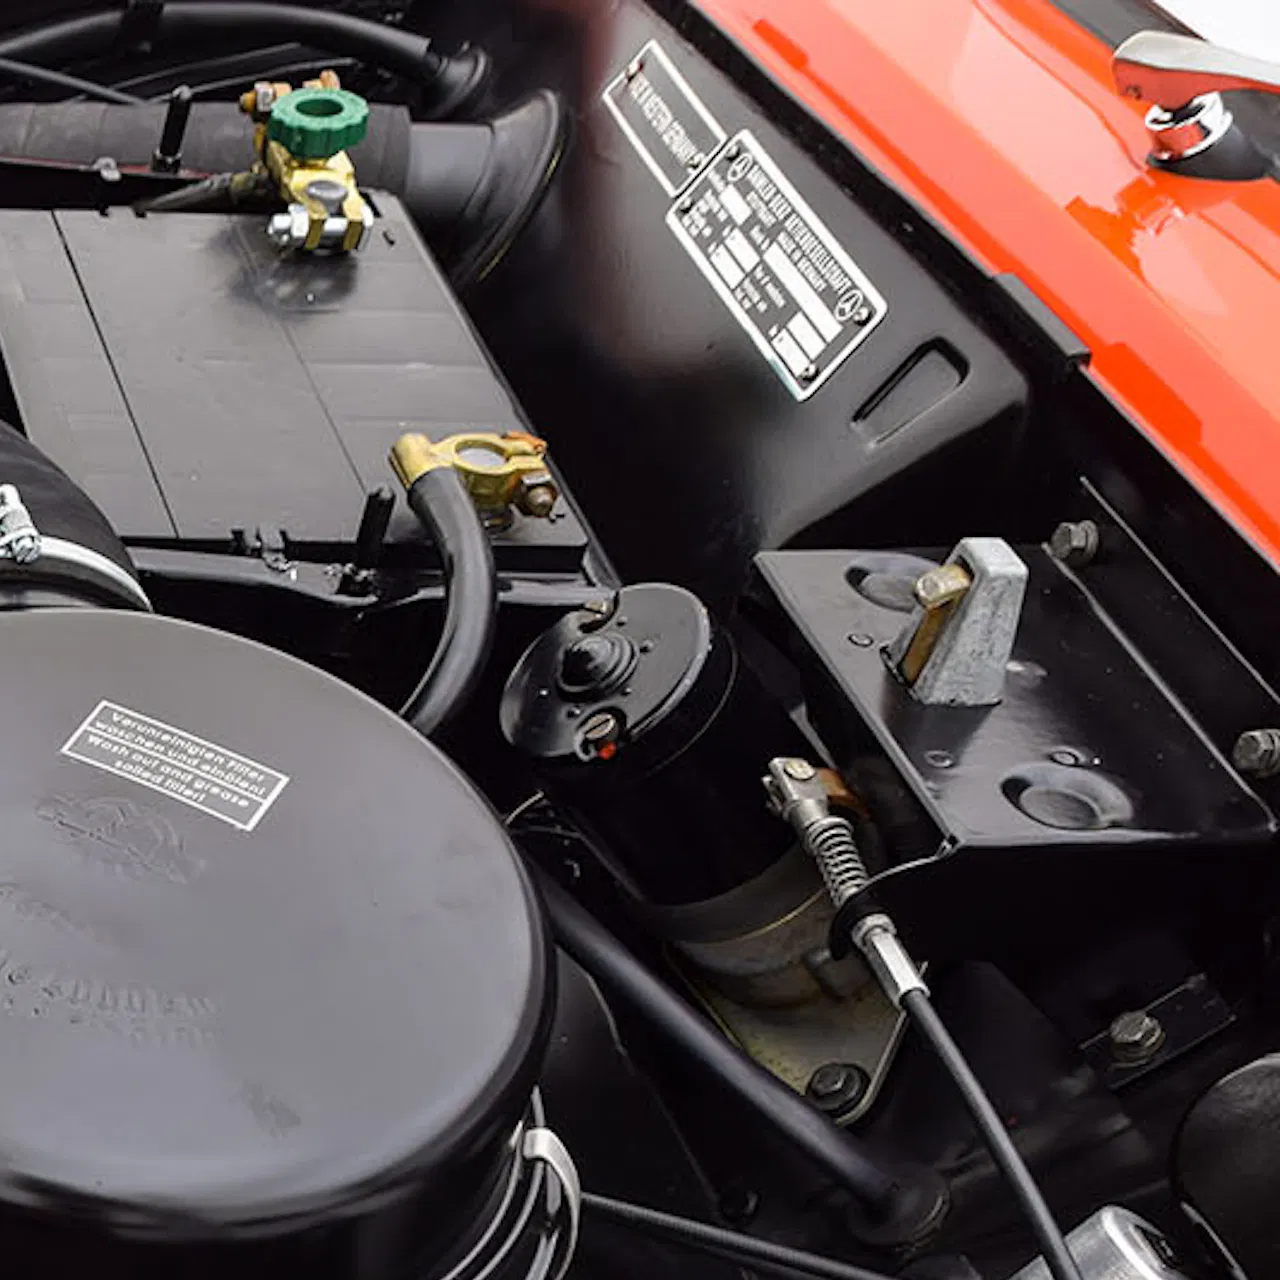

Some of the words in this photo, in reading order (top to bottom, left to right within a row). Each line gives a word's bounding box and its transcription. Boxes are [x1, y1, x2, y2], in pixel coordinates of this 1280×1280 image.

[167, 748, 200, 767] und
[88, 734, 130, 757] Wash
[131, 751, 159, 769] out
[160, 764, 192, 784] and
[192, 778, 250, 808] grease
[113, 759, 164, 785] soiled
